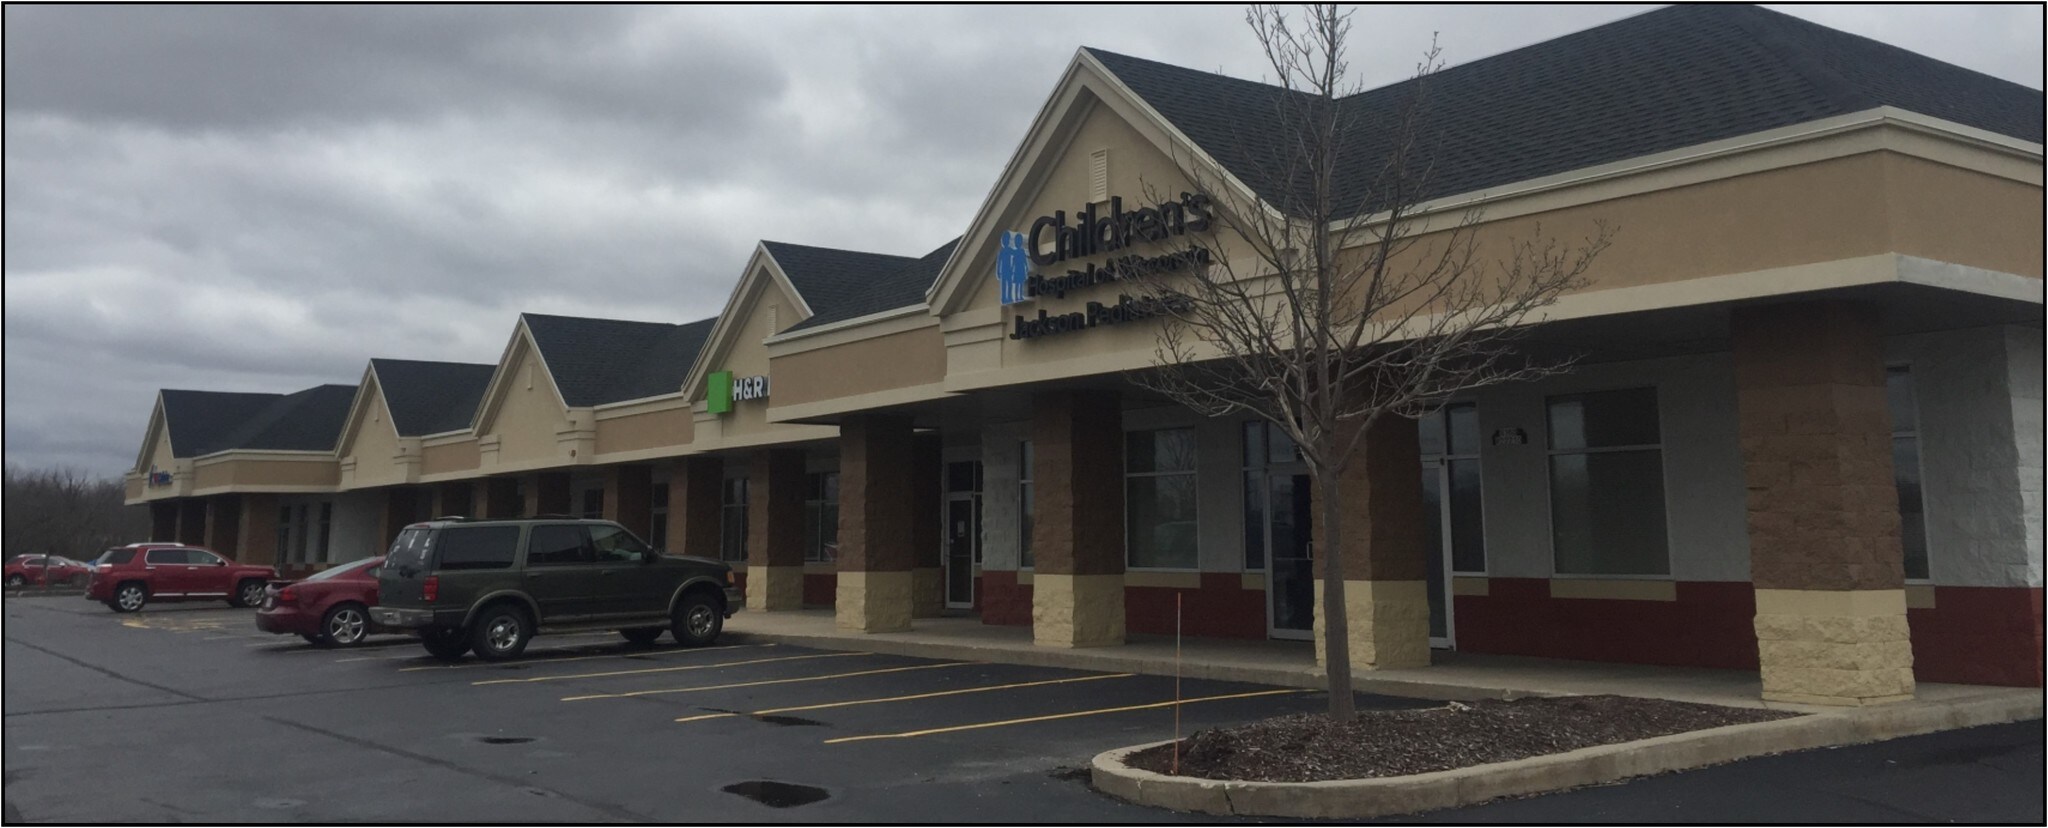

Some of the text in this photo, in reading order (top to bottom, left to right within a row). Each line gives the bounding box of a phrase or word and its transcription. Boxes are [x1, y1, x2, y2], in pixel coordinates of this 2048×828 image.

[1028, 191, 1214, 267] Children's
[1028, 263, 1095, 299] Hospital
[1095, 257, 1116, 284] of
[1009, 294, 1196, 340] Jackson Pediat
[732, 375, 766, 401] H&R
